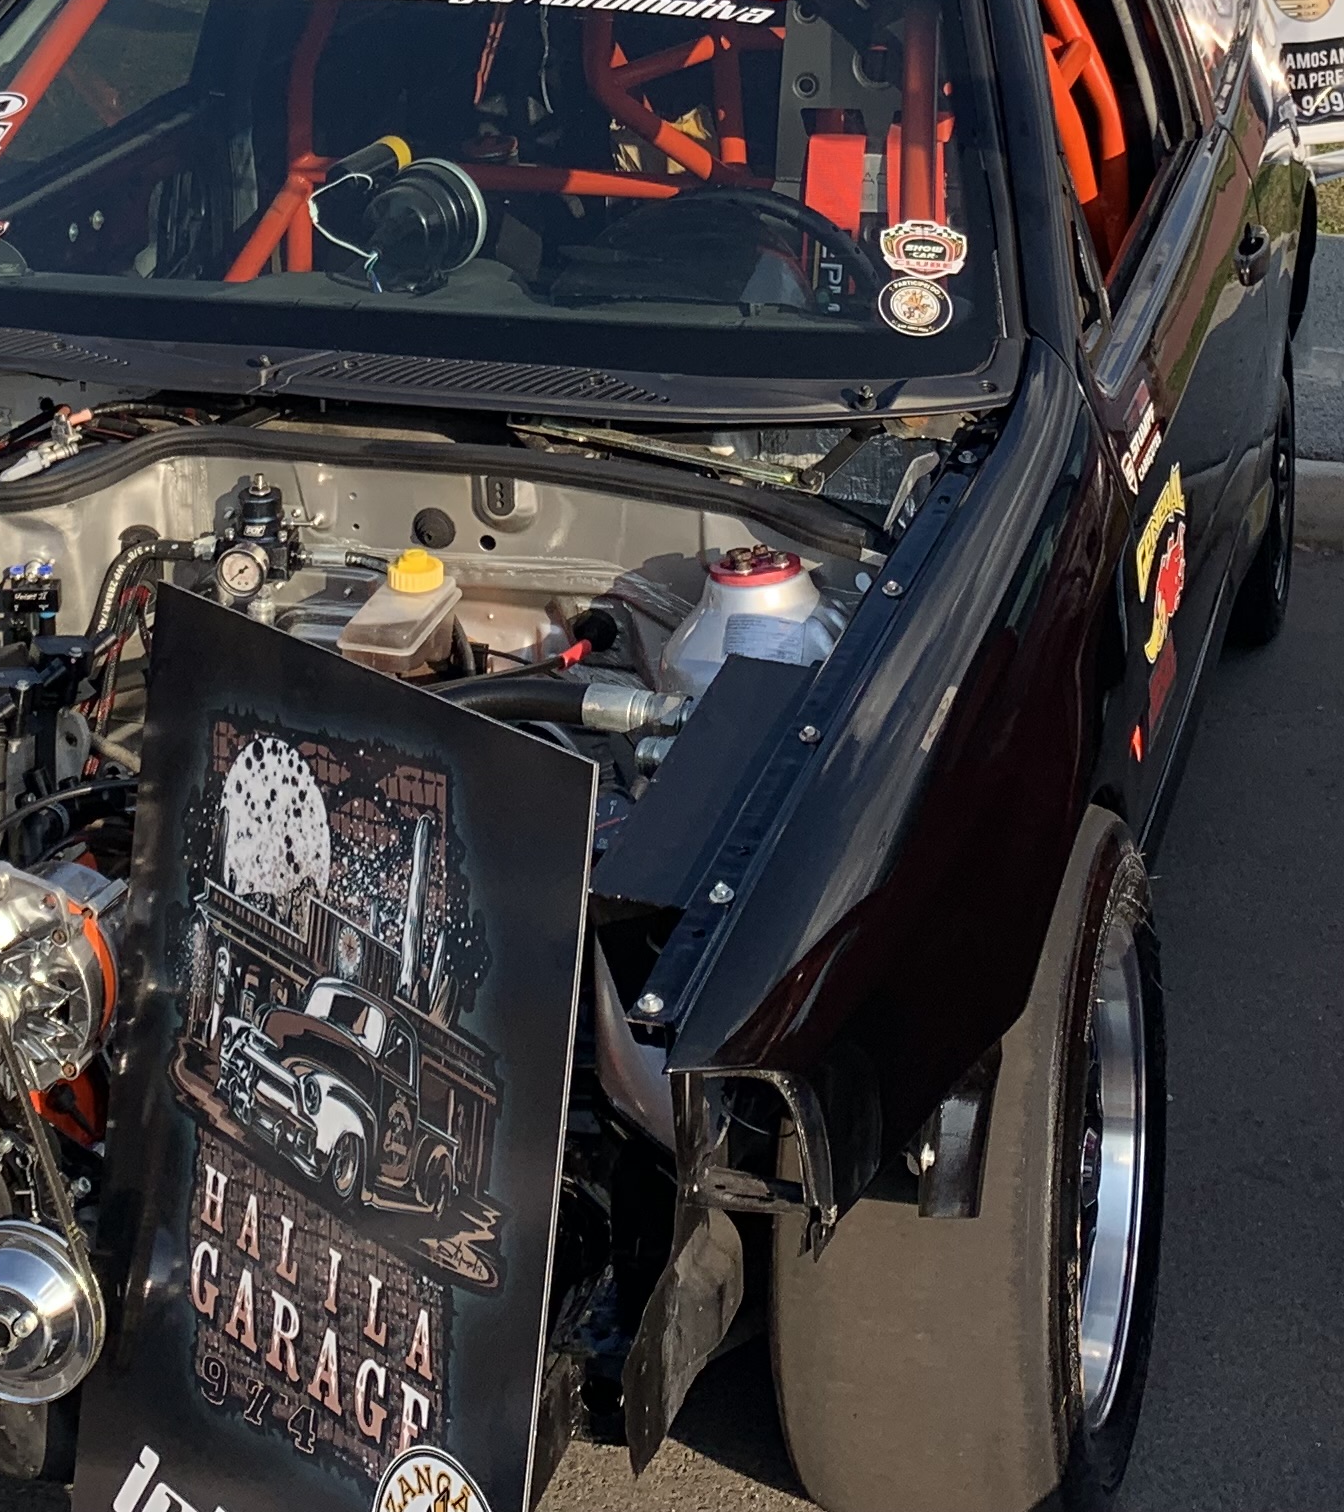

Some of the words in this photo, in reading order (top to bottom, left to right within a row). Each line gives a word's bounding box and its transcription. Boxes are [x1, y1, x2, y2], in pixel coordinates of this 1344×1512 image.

[1284, 51, 1328, 70] AMOS
[1287, 74, 1308, 91] RA
[904, 244, 944, 254] SHOW
[199, 1162, 434, 1381] HALILA
